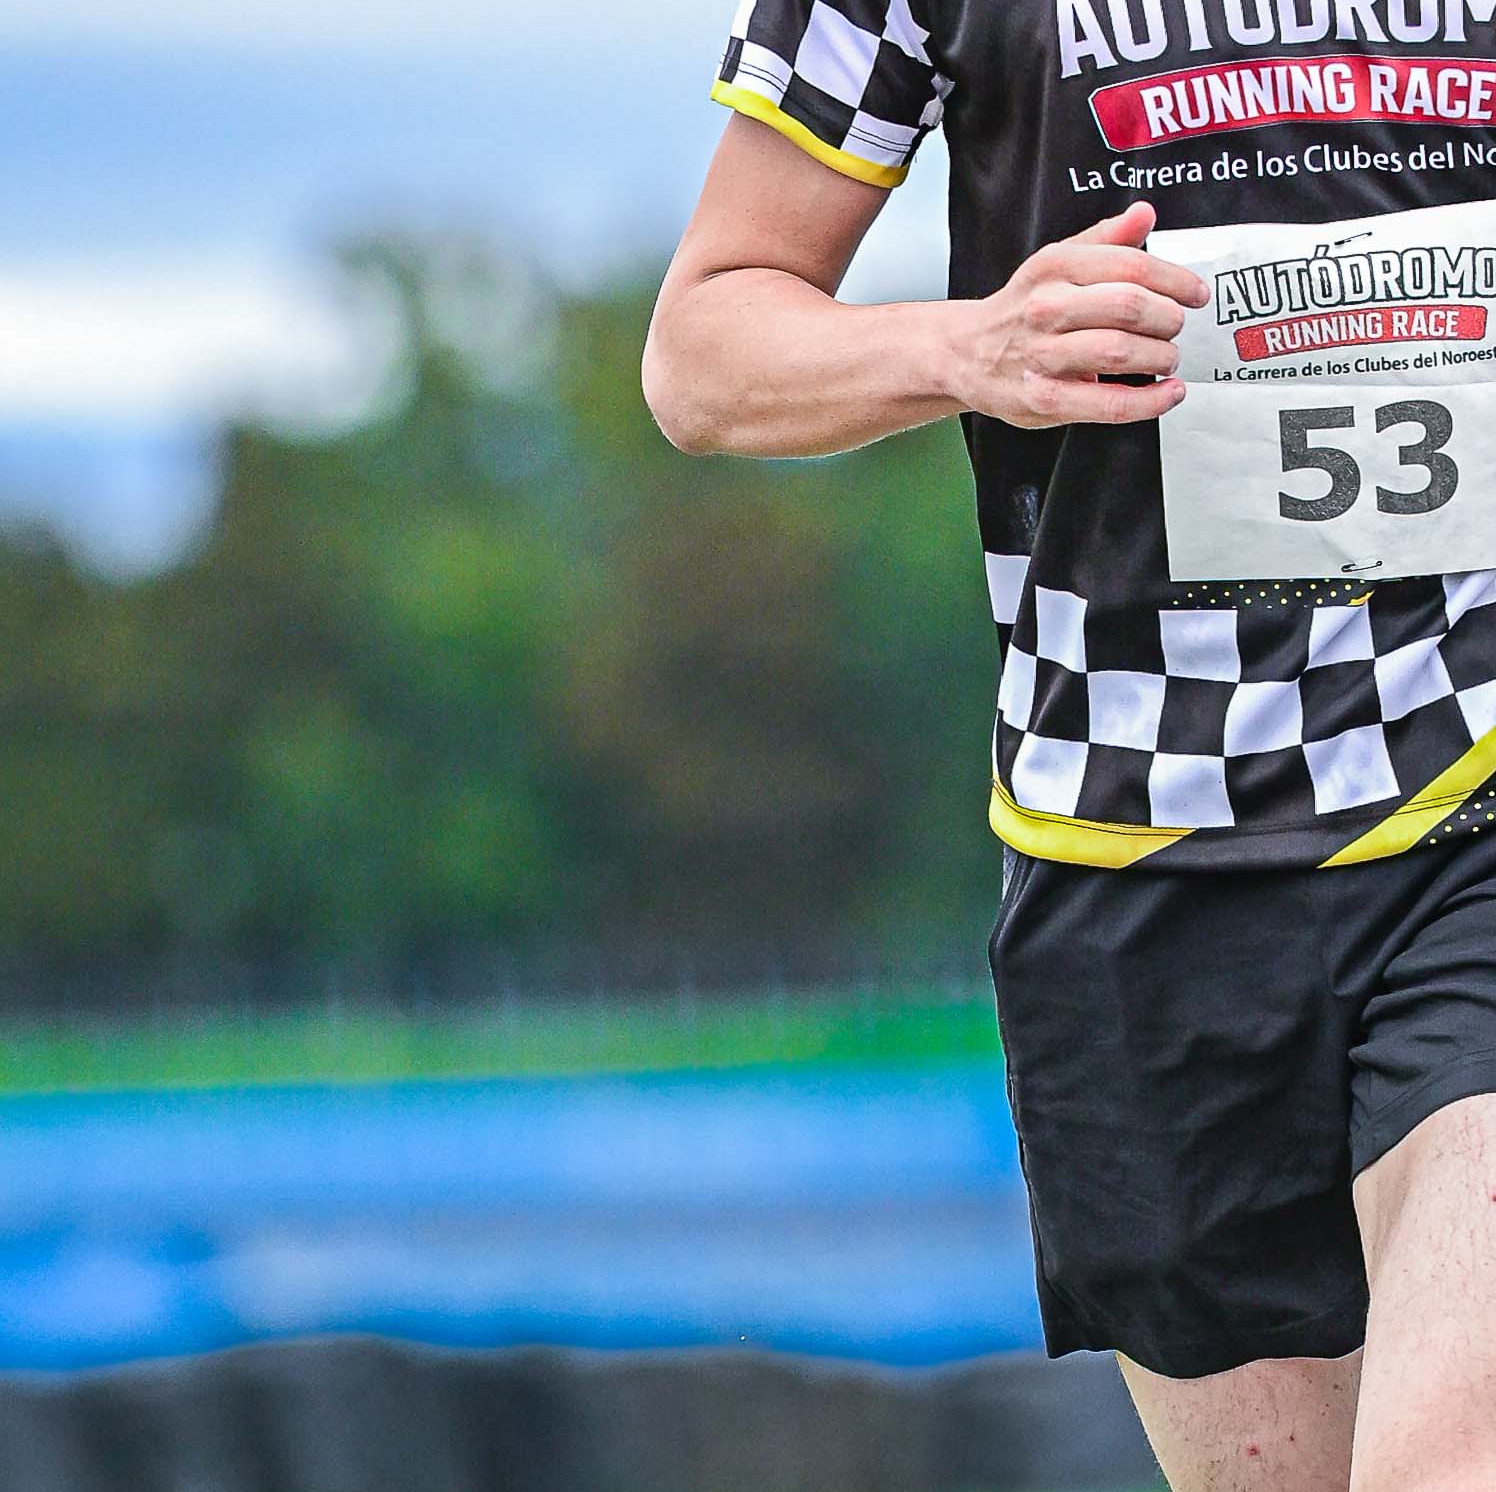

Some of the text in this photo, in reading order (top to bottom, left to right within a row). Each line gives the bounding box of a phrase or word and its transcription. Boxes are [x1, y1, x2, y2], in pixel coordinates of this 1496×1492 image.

[1139, 62, 1496, 140] RUNNING RACE
[1069, 167, 1104, 192] La
[1109, 160, 1203, 189] Carrera
[1211, 151, 1248, 181] de
[1256, 150, 1299, 177] los
[1303, 143, 1403, 173] Clubes
[1408, 142, 1454, 171] del
[1263, 309, 1460, 355] RUNNING RACE
[1213, 368, 1232, 382] La
[1236, 366, 1297, 381] Carrera
[1301, 361, 1323, 377] de
[1326, 360, 1350, 375] los
[1354, 356, 1409, 373] Clubes
[1413, 351, 1438, 369] del
[1278, 399, 1460, 522] 53
